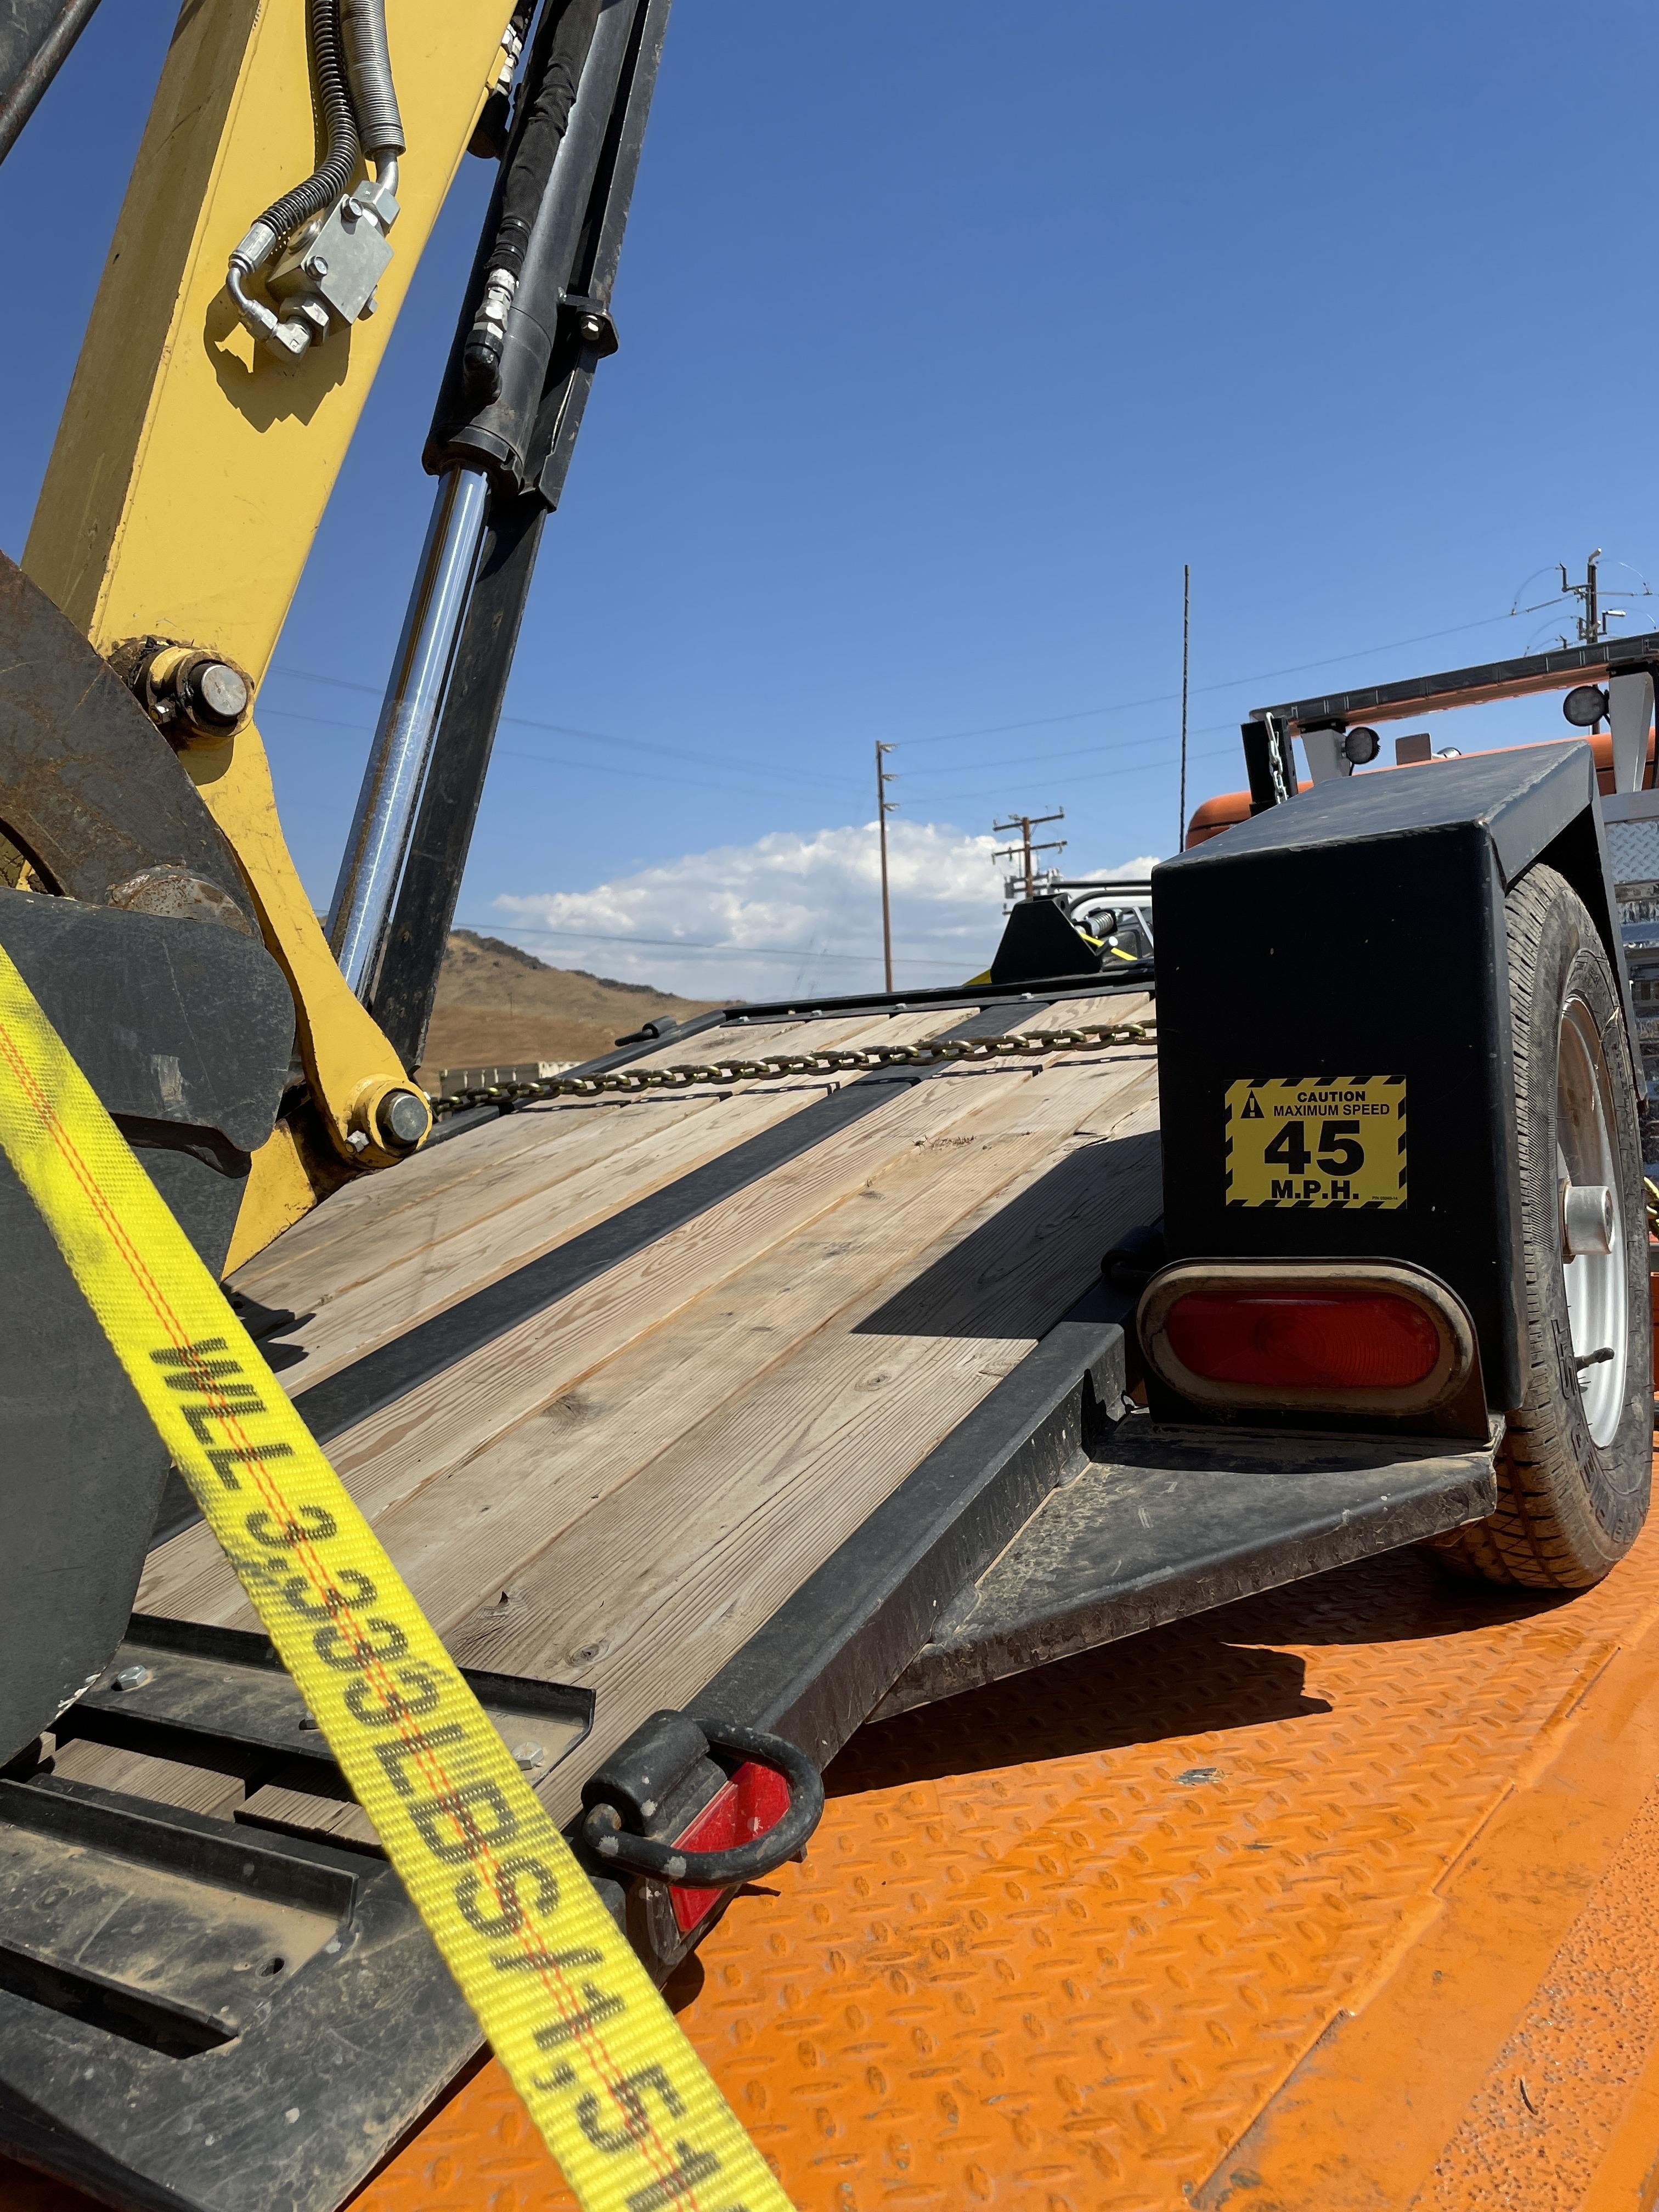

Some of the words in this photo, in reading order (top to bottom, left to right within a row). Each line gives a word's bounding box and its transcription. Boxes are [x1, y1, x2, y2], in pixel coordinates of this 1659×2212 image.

[1297, 1091, 1365, 1103] CAUTION
[1273, 1104, 1339, 1116] MAXIMUM
[1342, 1103, 1390, 1116] SPEED
[1264, 1120, 1365, 1177] 45
[1271, 1180, 1359, 1200] M.P.H.
[149, 1336, 293, 1491] WLL
[245, 1504, 749, 2212] 3,333LBS/1,51
